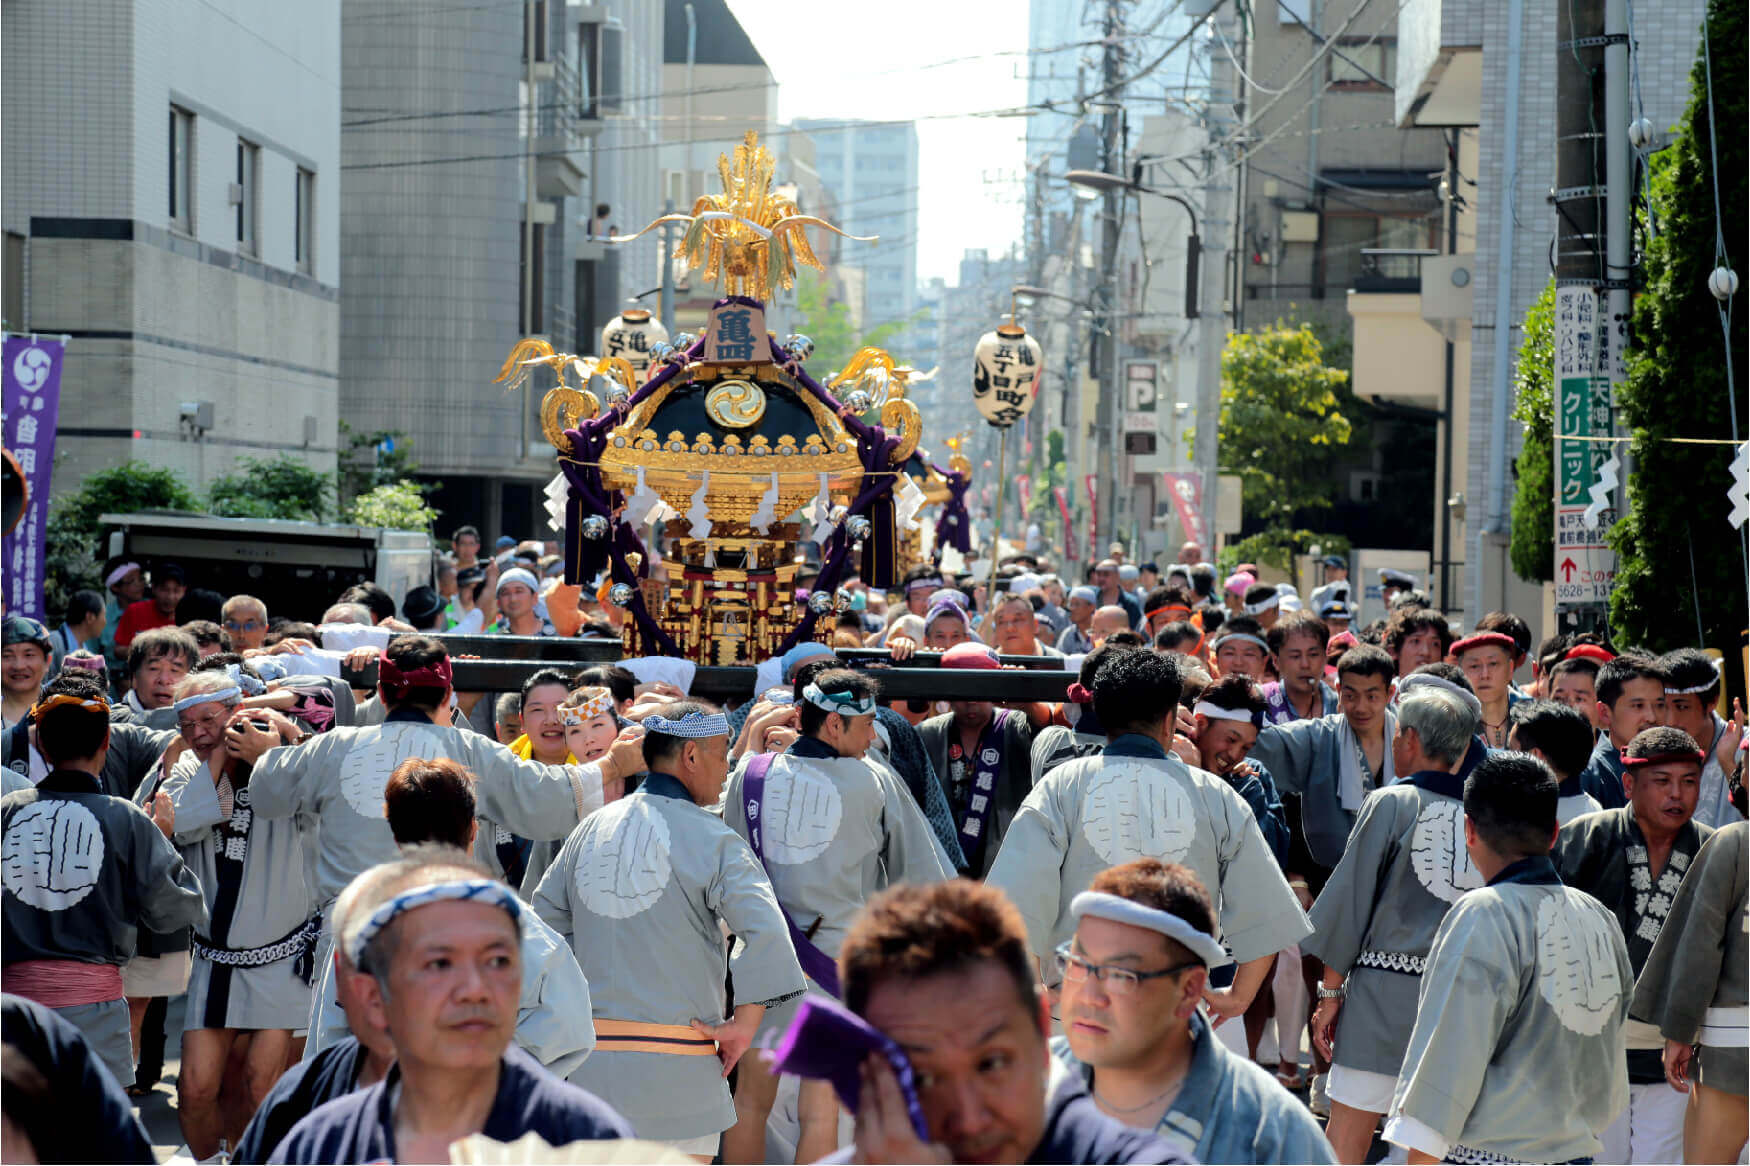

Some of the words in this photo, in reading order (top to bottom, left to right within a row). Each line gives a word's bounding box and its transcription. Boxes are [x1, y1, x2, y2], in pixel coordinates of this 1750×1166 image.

[1128, 380, 1155, 411] P
[1563, 391, 1582, 501] クリニック
